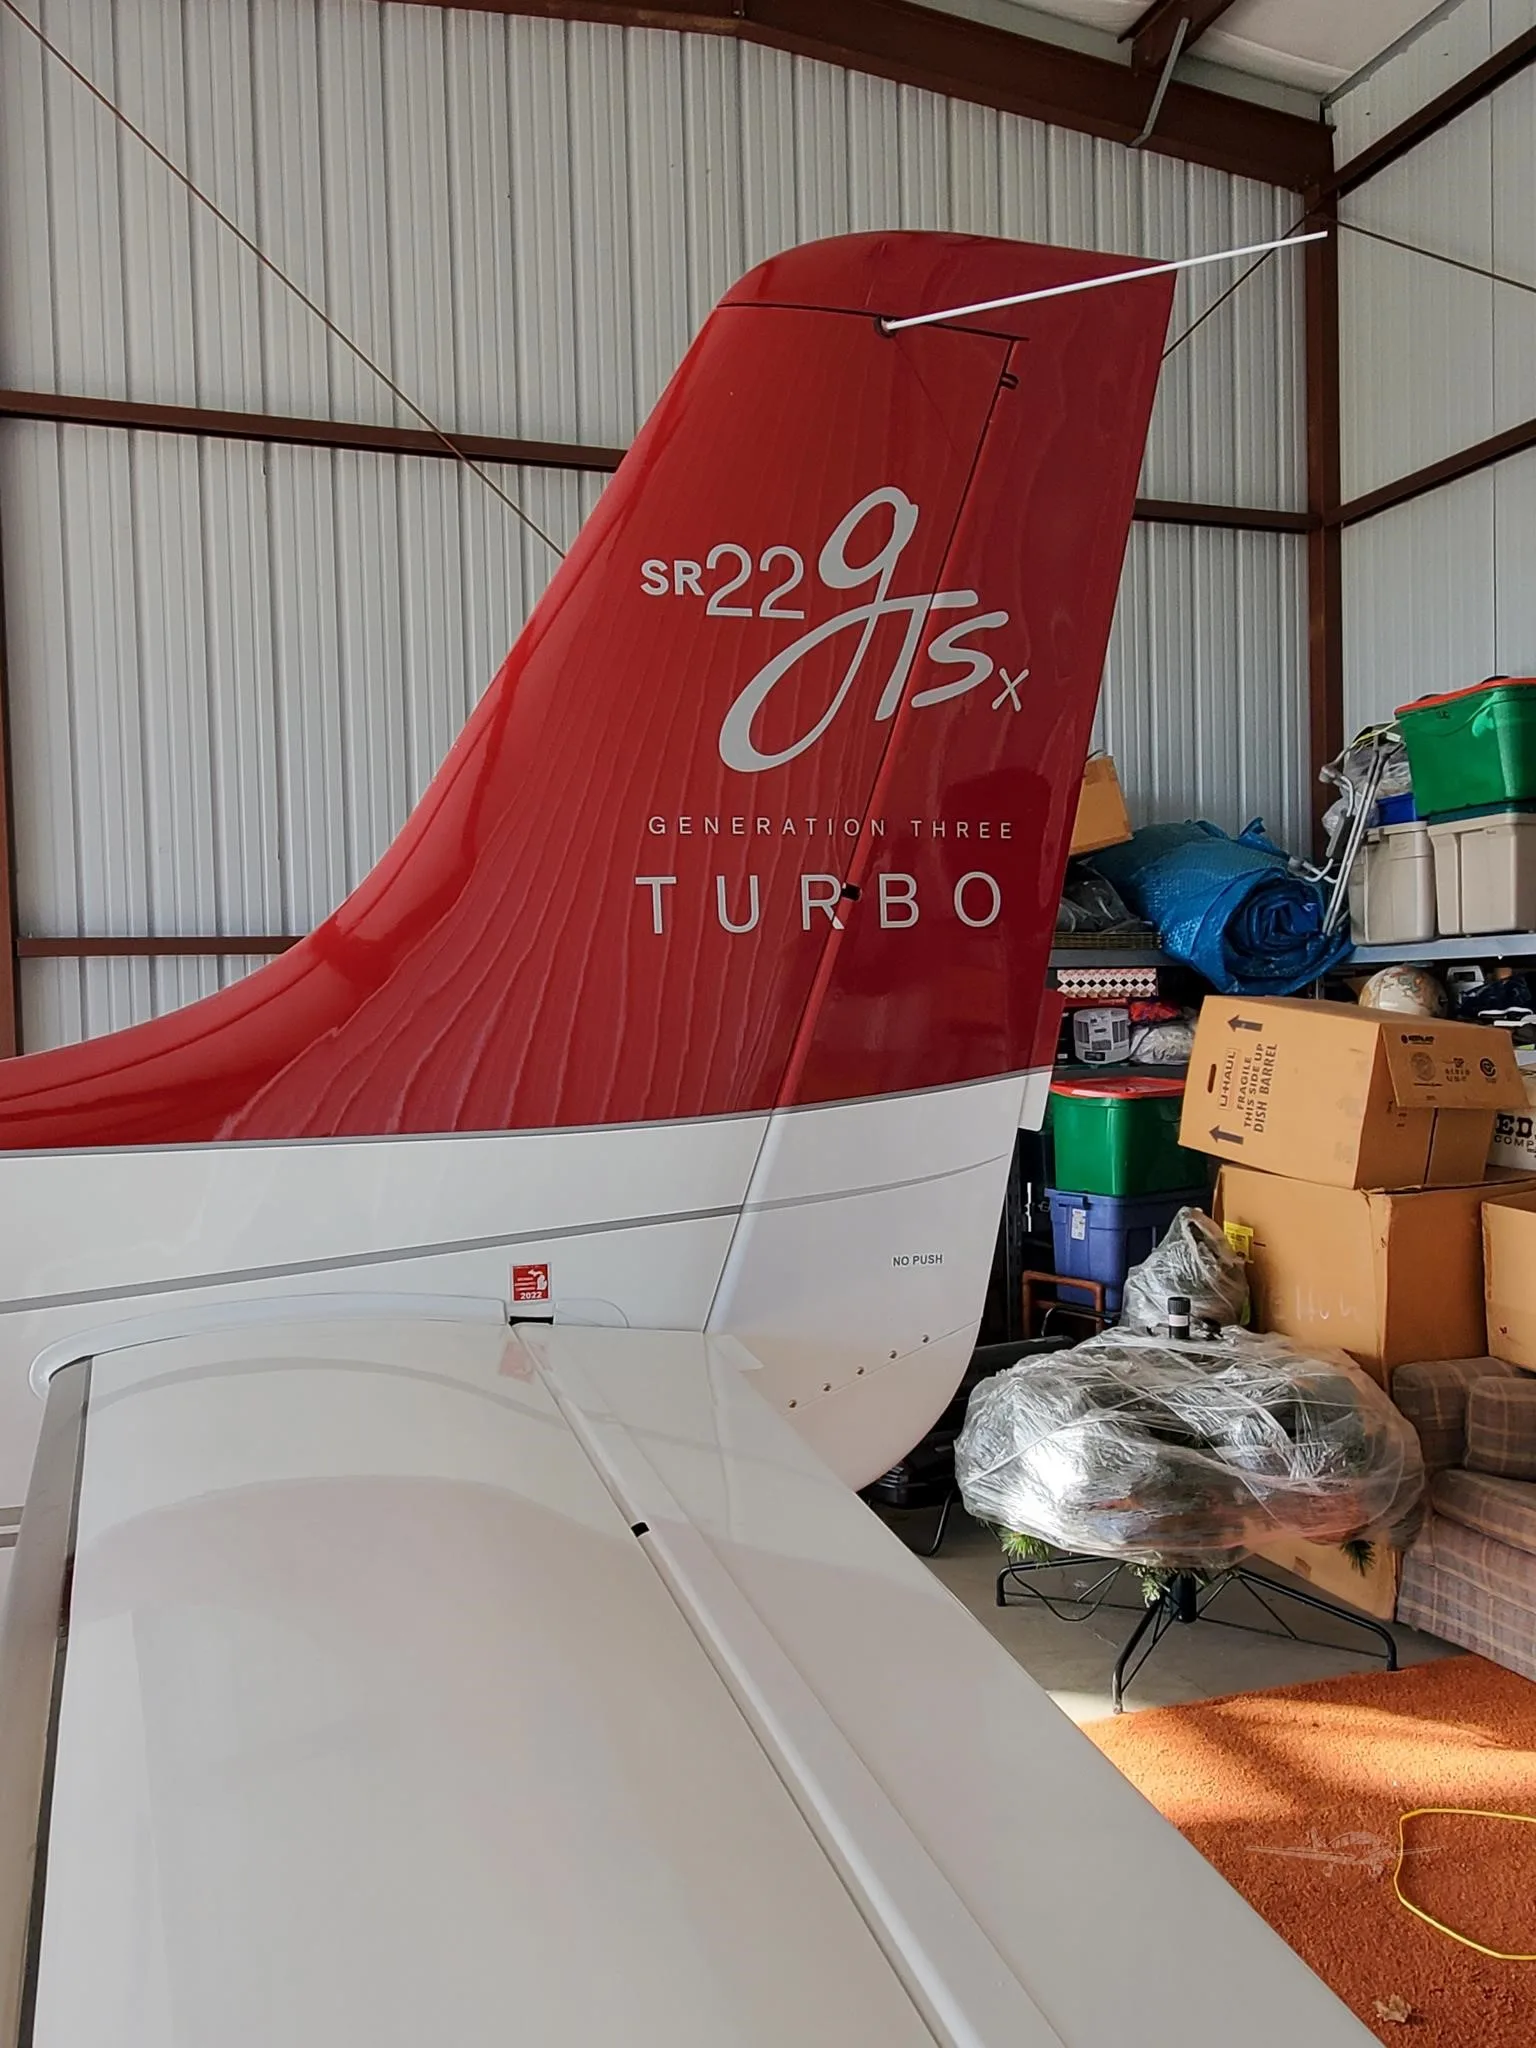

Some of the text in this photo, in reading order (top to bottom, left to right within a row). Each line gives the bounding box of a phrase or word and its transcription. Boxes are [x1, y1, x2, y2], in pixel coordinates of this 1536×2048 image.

[640, 543, 805, 619] SR22
[648, 816, 1013, 839] GENERATION THREE
[635, 871, 1001, 934] TURBO
[1237, 1056, 1252, 1110] FRAGILE
[1244, 1043, 1264, 1128] THIS SIDE UP
[1253, 1044, 1278, 1133] DISH BARREL
[1495, 1113, 1536, 1139] ED
[893, 1254, 943, 1267] NO PUSH
[520, 1291, 543, 1300] 2022
